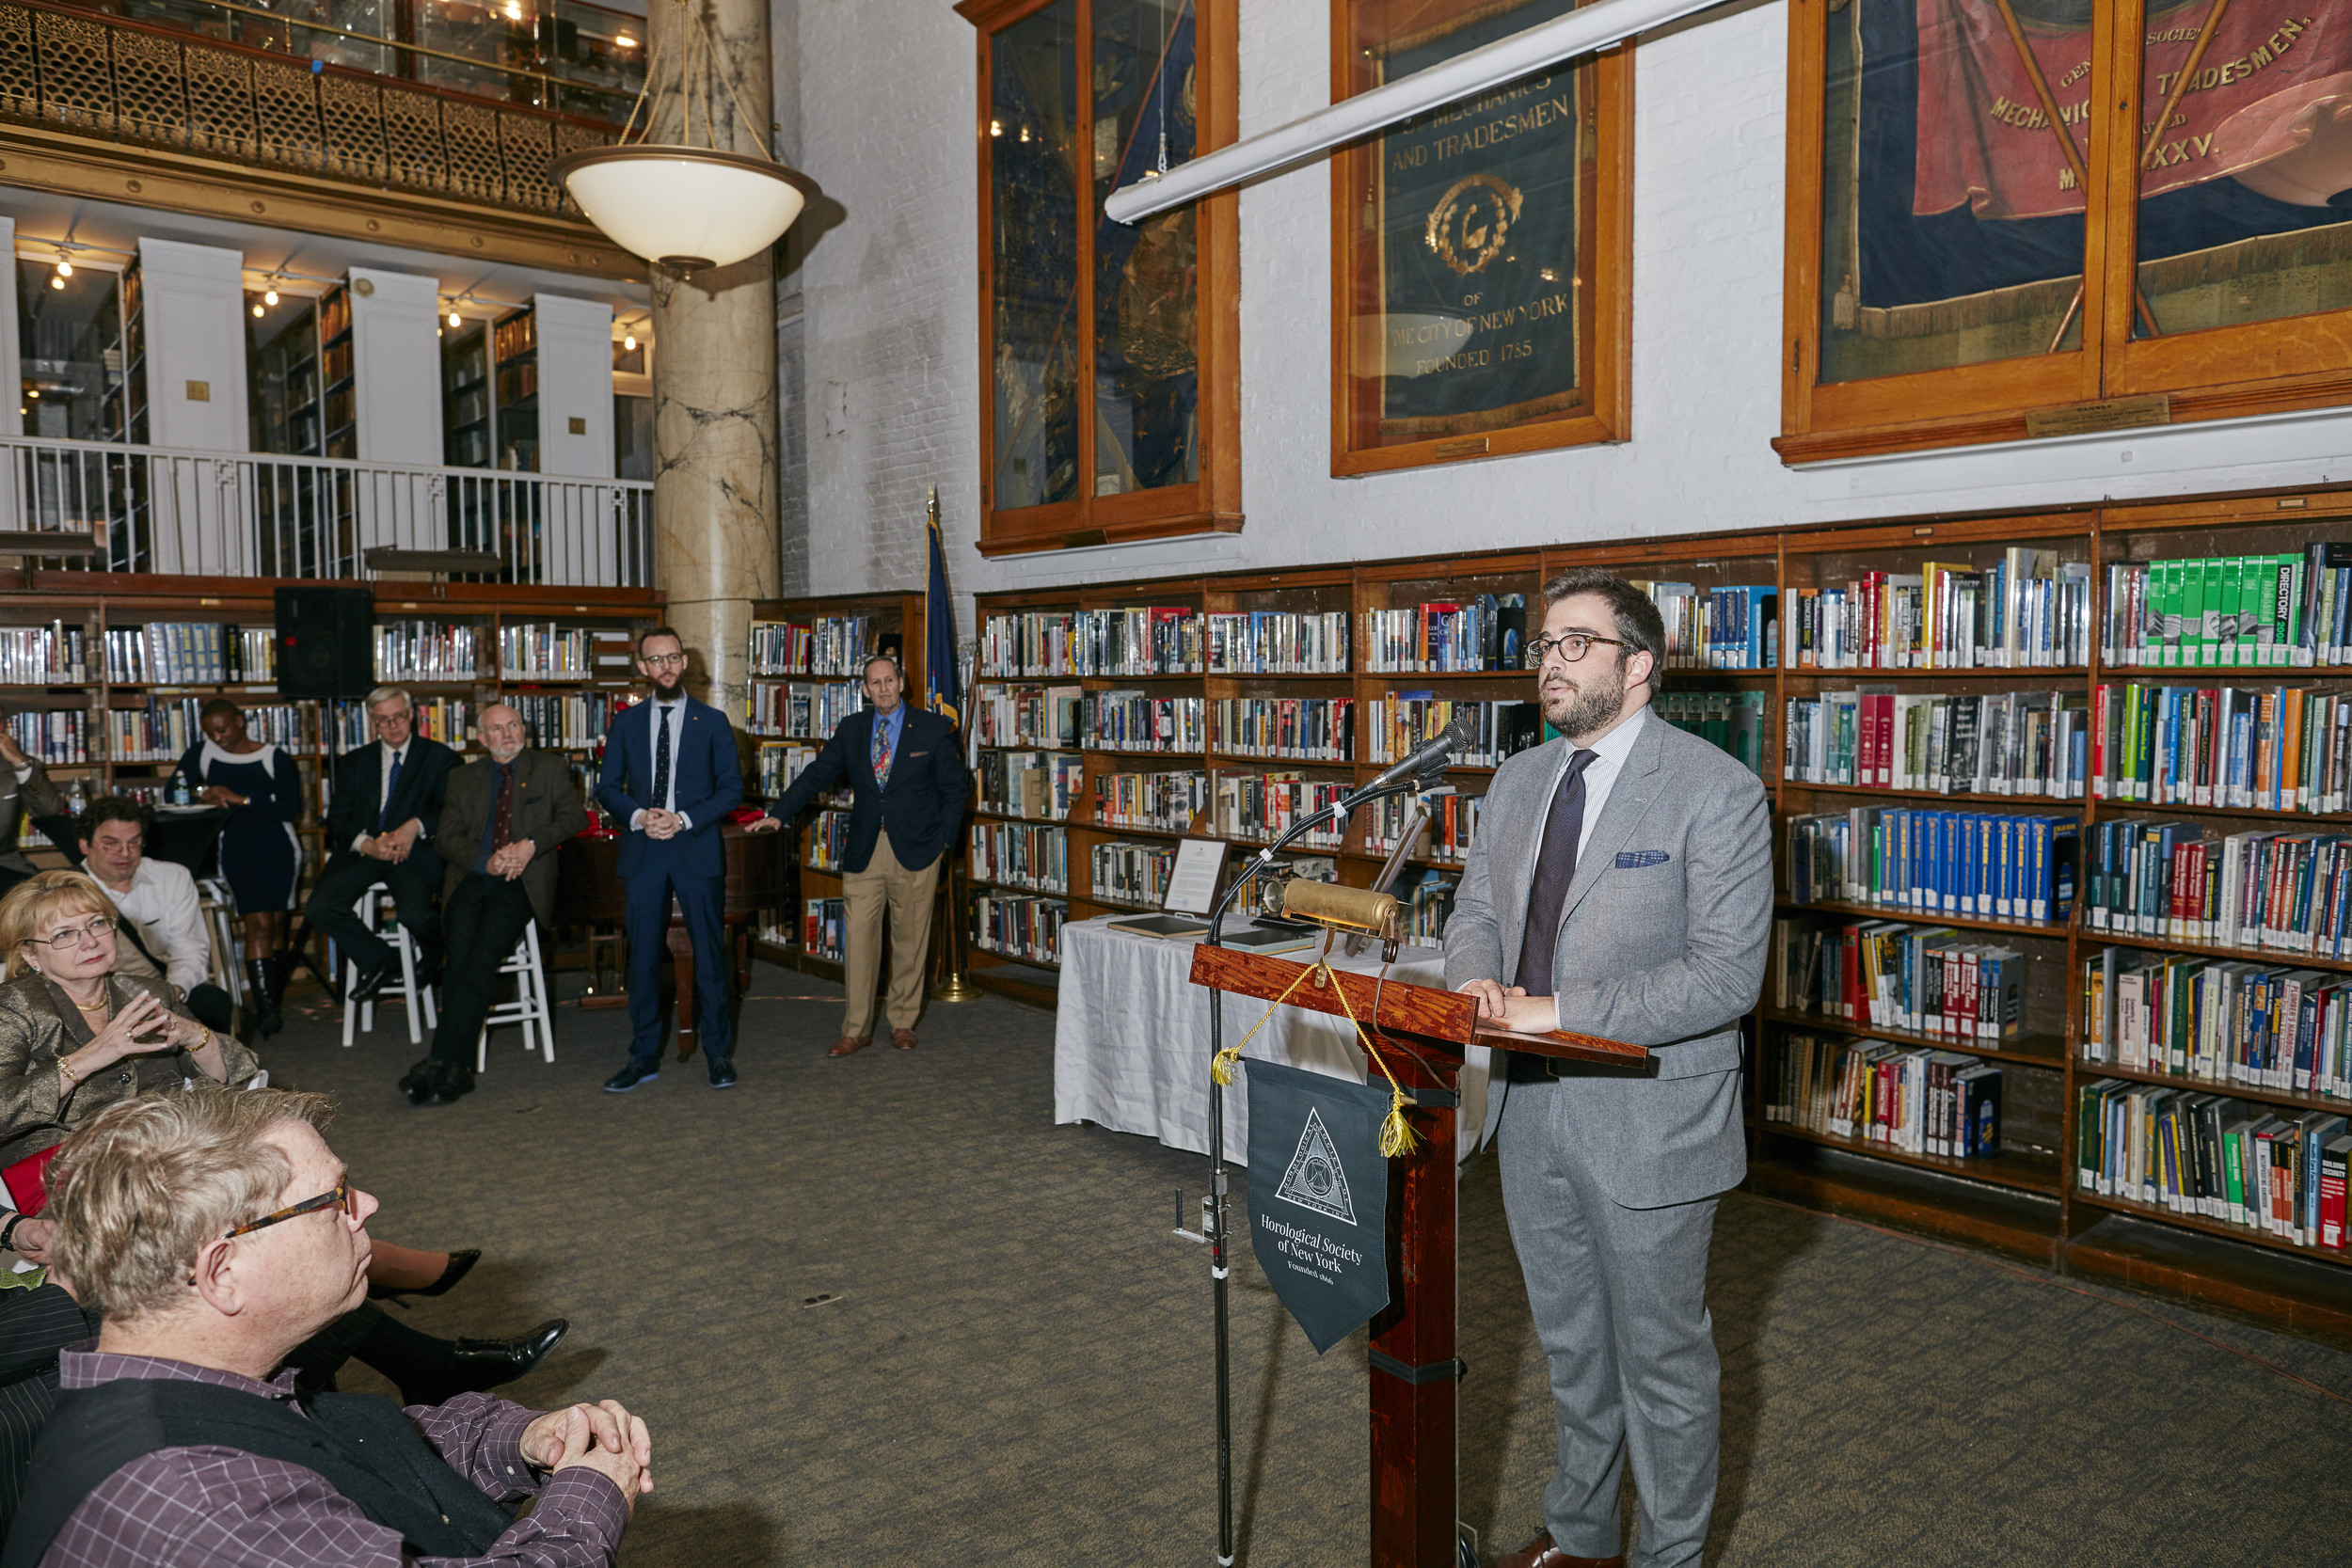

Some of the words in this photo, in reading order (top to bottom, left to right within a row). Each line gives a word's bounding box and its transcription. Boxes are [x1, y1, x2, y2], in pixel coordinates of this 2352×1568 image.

[2146, 28, 2220, 45] SOCIE
[1391, 145, 1427, 173] AND
[1433, 94, 1568, 161] TRADESMEN
[1463, 292, 1484, 307] OF
[1418, 321, 1453, 344] CITY
[1455, 317, 1477, 338] OF
[1479, 308, 1516, 333] NEW
[1518, 293, 1568, 321] YORK
[1416, 349, 1490, 374] FOUNDED
[1502, 340, 1533, 361] 1785
[2277, 567, 2291, 621] DIRECTORY
[1804, 599, 1812, 629] CONCRETE
[2272, 998, 2280, 1034] PLUMBING
[2288, 986, 2299, 1022] PLUMBER'S
[2285, 1022, 2296, 1058] HANDBOOK
[2322, 1159, 2345, 1170] BUILDING
[2322, 1166, 2345, 1179] SECURITY
[1261, 1213, 1321, 1250] Horological
[1322, 1237, 1363, 1266] Society
[1278, 1239, 1290, 1254] of
[1291, 1243, 1313, 1262] New
[1314, 1252, 1343, 1274] York
[1287, 1260, 1319, 1278] Founded
